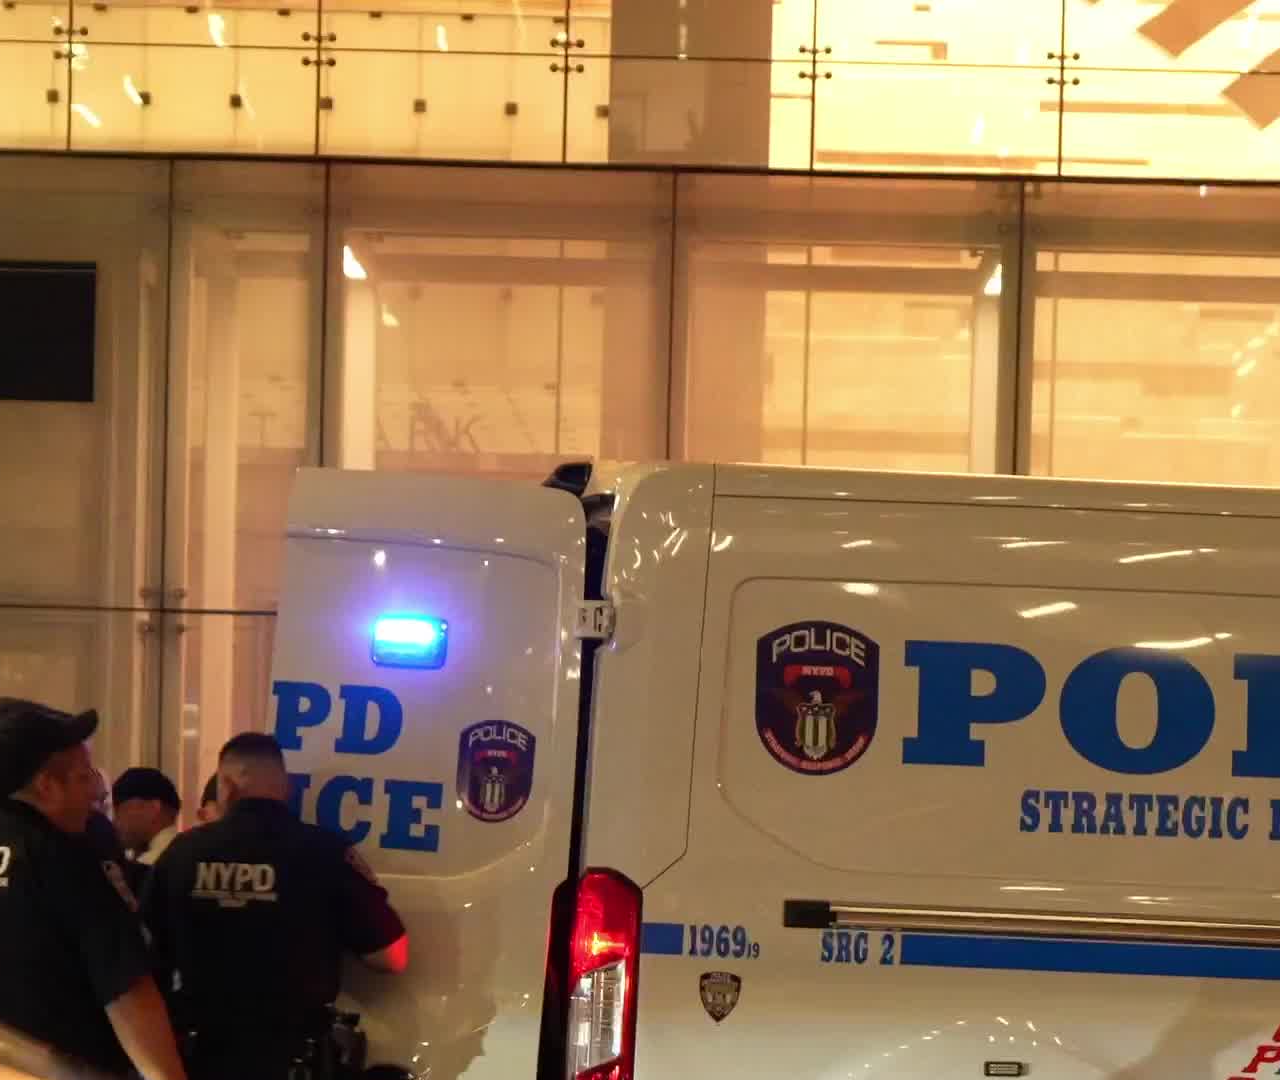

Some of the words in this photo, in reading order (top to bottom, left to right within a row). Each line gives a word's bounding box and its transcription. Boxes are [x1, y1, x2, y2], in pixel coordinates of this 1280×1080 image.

[772, 628, 867, 667] POLICE
[272, 680, 403, 756] PD
[468, 724, 529, 752] POLICE
[1019, 788, 1249, 841] STRATEGIC
[194, 862, 275, 891] NYPD
[820, 931, 870, 964] SRG
[879, 933, 896, 966] 2
